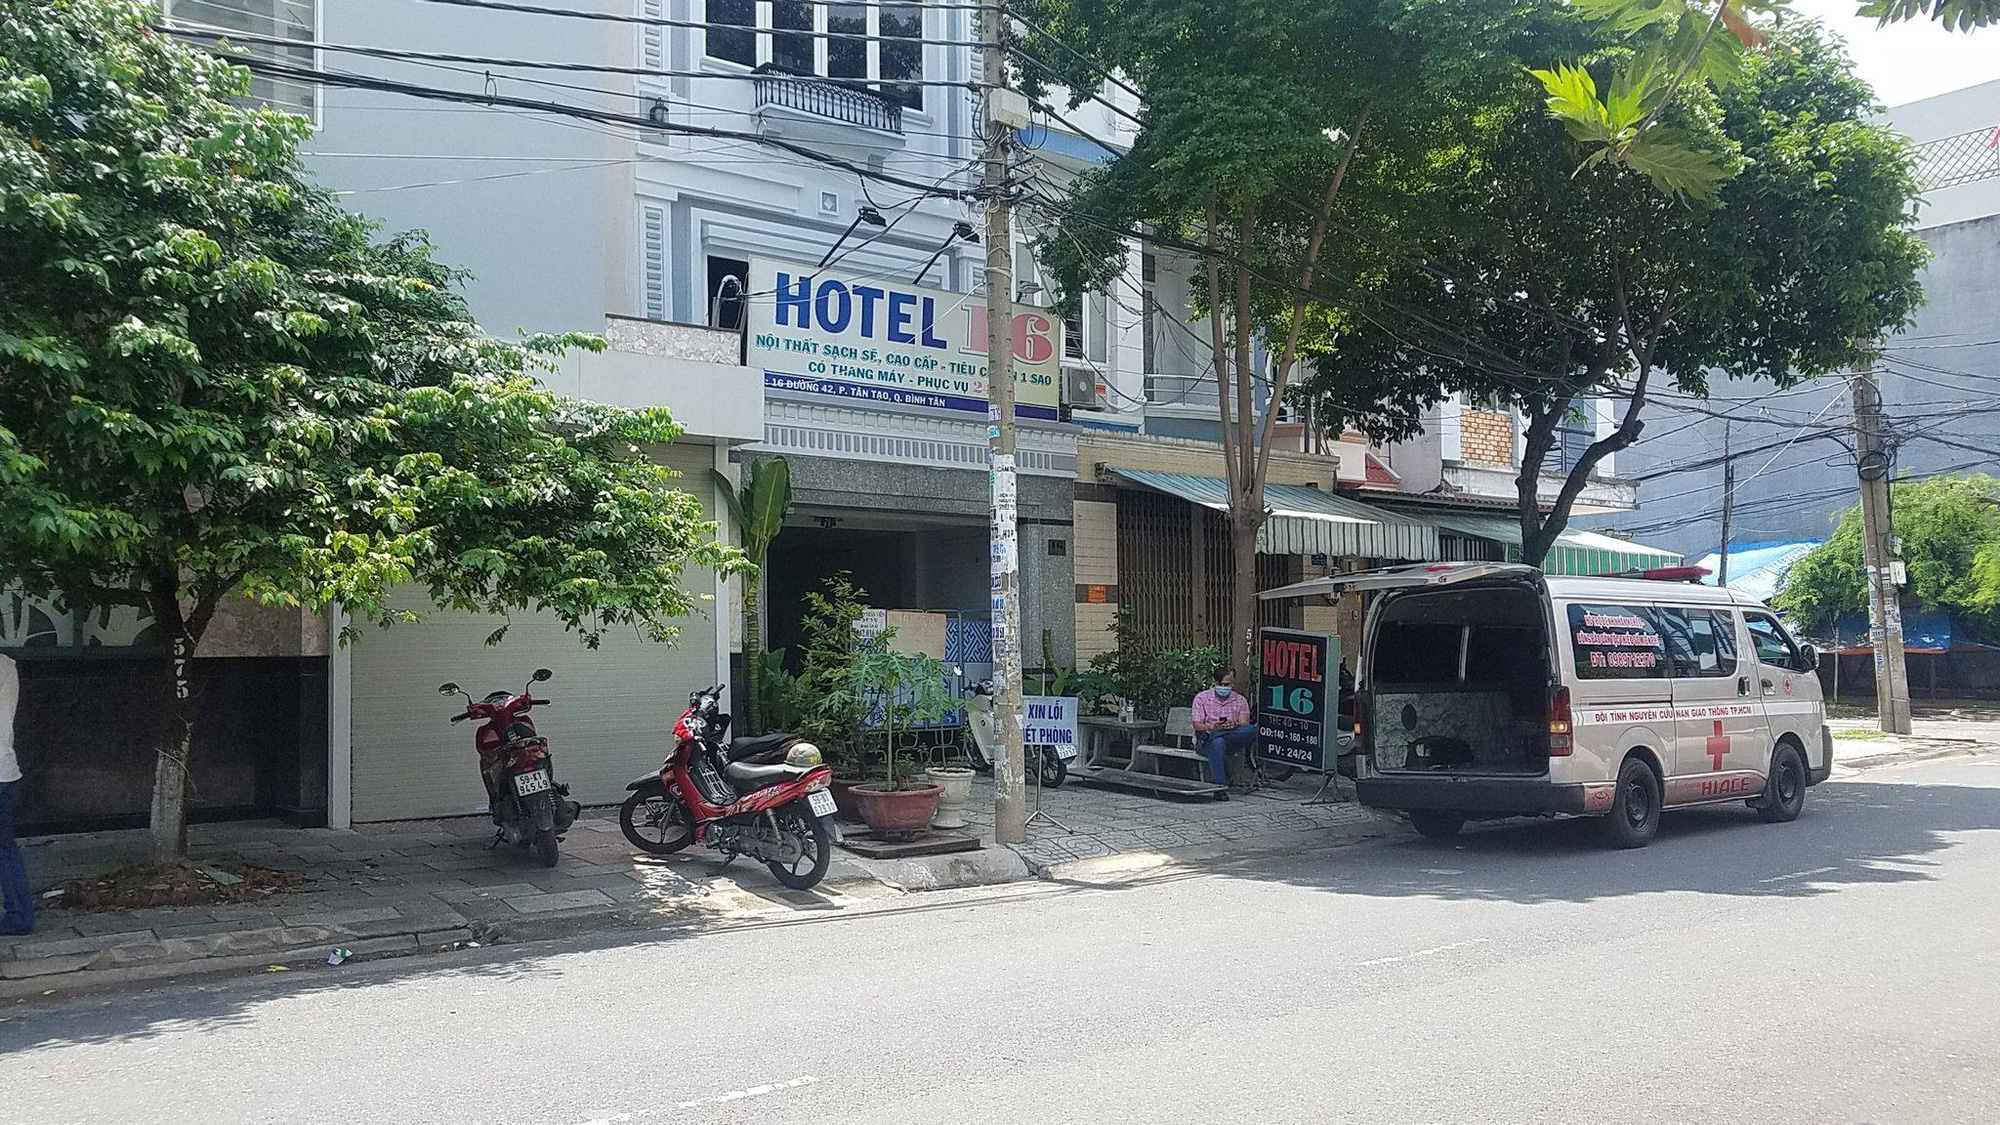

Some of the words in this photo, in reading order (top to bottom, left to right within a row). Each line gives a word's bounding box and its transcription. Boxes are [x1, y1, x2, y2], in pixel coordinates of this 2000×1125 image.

[775, 272, 947, 349] HOTEL
[958, 303, 1053, 365] 16
[756, 333, 779, 350] NỘI
[784, 337, 819, 354] THẤT
[823, 344, 857, 360] SẠCH
[886, 353, 910, 366] CAO
[915, 355, 938, 370] CẤP
[948, 360, 976, 375] TIÊU
[1021, 372, 1027, 383] 1
[1030, 374, 1051, 387] SAO
[808, 360, 825, 373] CÓ
[831, 364, 873, 380] THANG
[878, 368, 905, 384] MÁY
[917, 375, 949, 390] PHỤC
[954, 381, 968, 394] VỤ
[821, 385, 836, 395] 42,
[839, 387, 848, 395] P.
[851, 385, 868, 398] TÂN
[894, 394, 902, 402] Q.
[905, 393, 926, 404] BÌNH
[928, 396, 945, 407] TÂN
[1244, 628, 1253, 666] 574
[173, 637, 189, 699] 575
[1263, 639, 1322, 682] HOTEL
[1028, 704, 1045, 719] XIN
[1048, 700, 1063, 720] LỖI
[1267, 684, 1315, 715] 16
[1691, 708, 1706, 717] GIAO
[1040, 725, 1072, 744] PHÒNG
[1290, 732, 1301, 743] 160
[1268, 744, 1285, 756] PV:
[1287, 747, 1312, 761] 24/24
[519, 771, 542, 785] 59-K1
[519, 779, 549, 794] 945.49
[1701, 776, 1750, 796] HIACE
